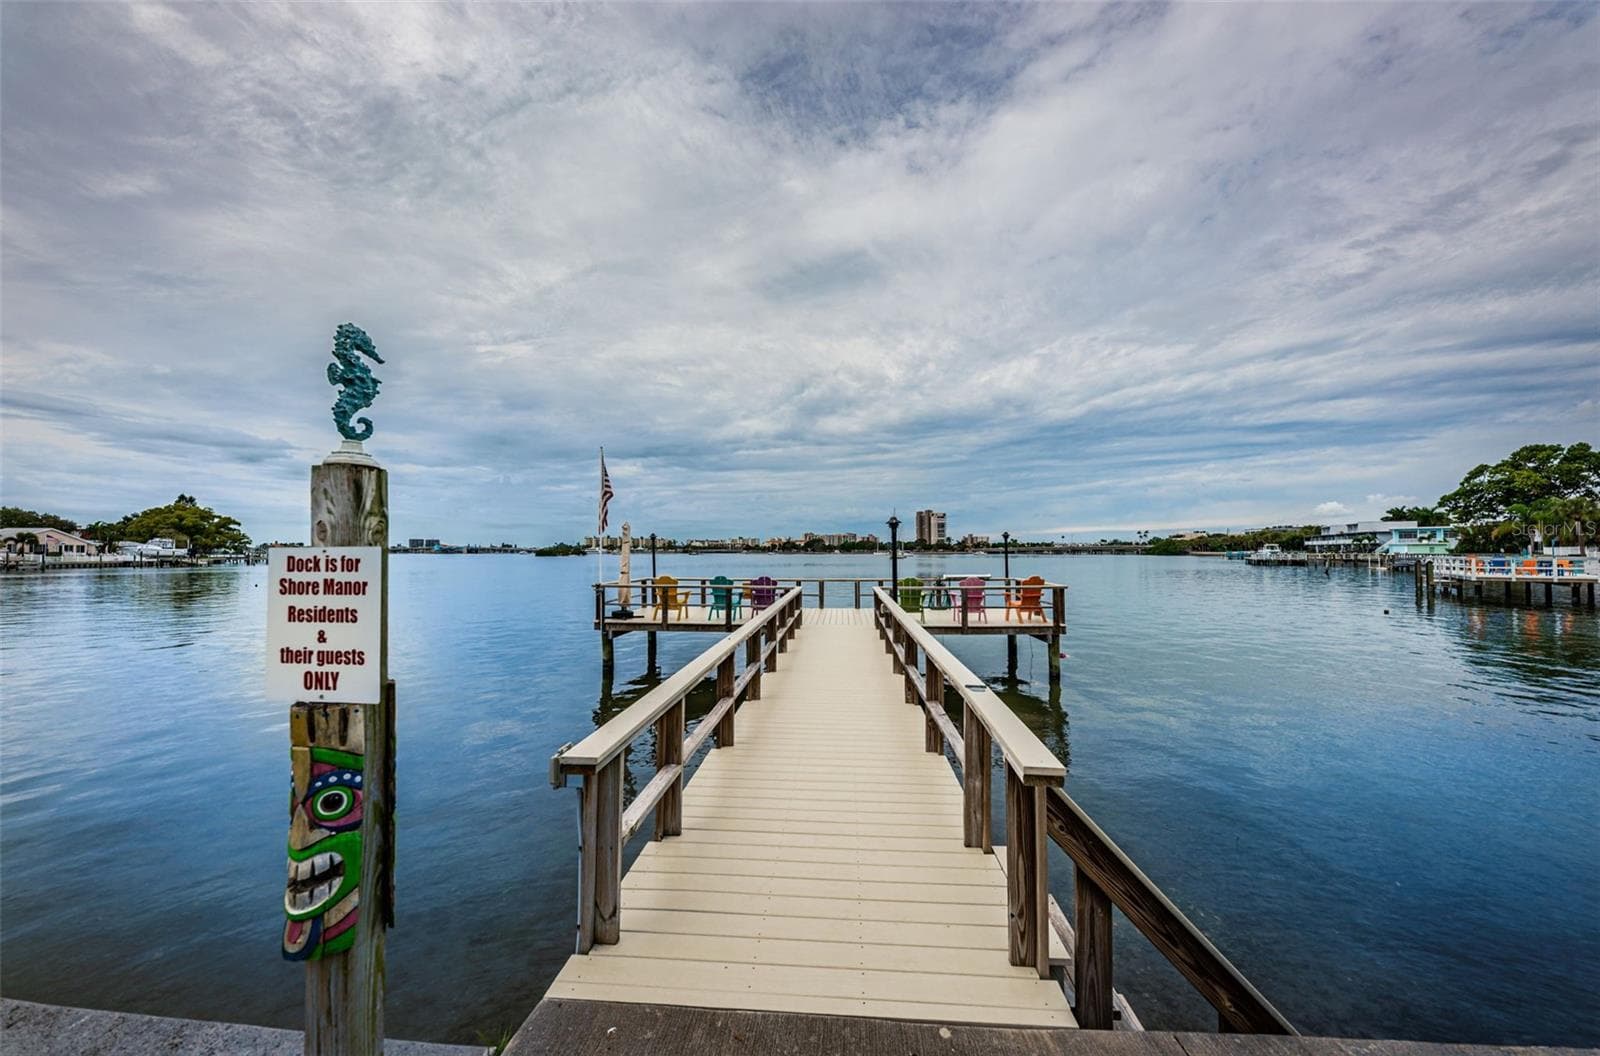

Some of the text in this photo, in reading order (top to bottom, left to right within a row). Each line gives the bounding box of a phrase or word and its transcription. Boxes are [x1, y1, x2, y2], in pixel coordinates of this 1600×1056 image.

[287, 555, 361, 572] Dock is for
[279, 578, 368, 595] Shore Manor
[287, 605, 358, 623] Residents
[317, 630, 327, 643] &
[280, 647, 365, 666] their guests
[303, 671, 339, 691] ONLY
